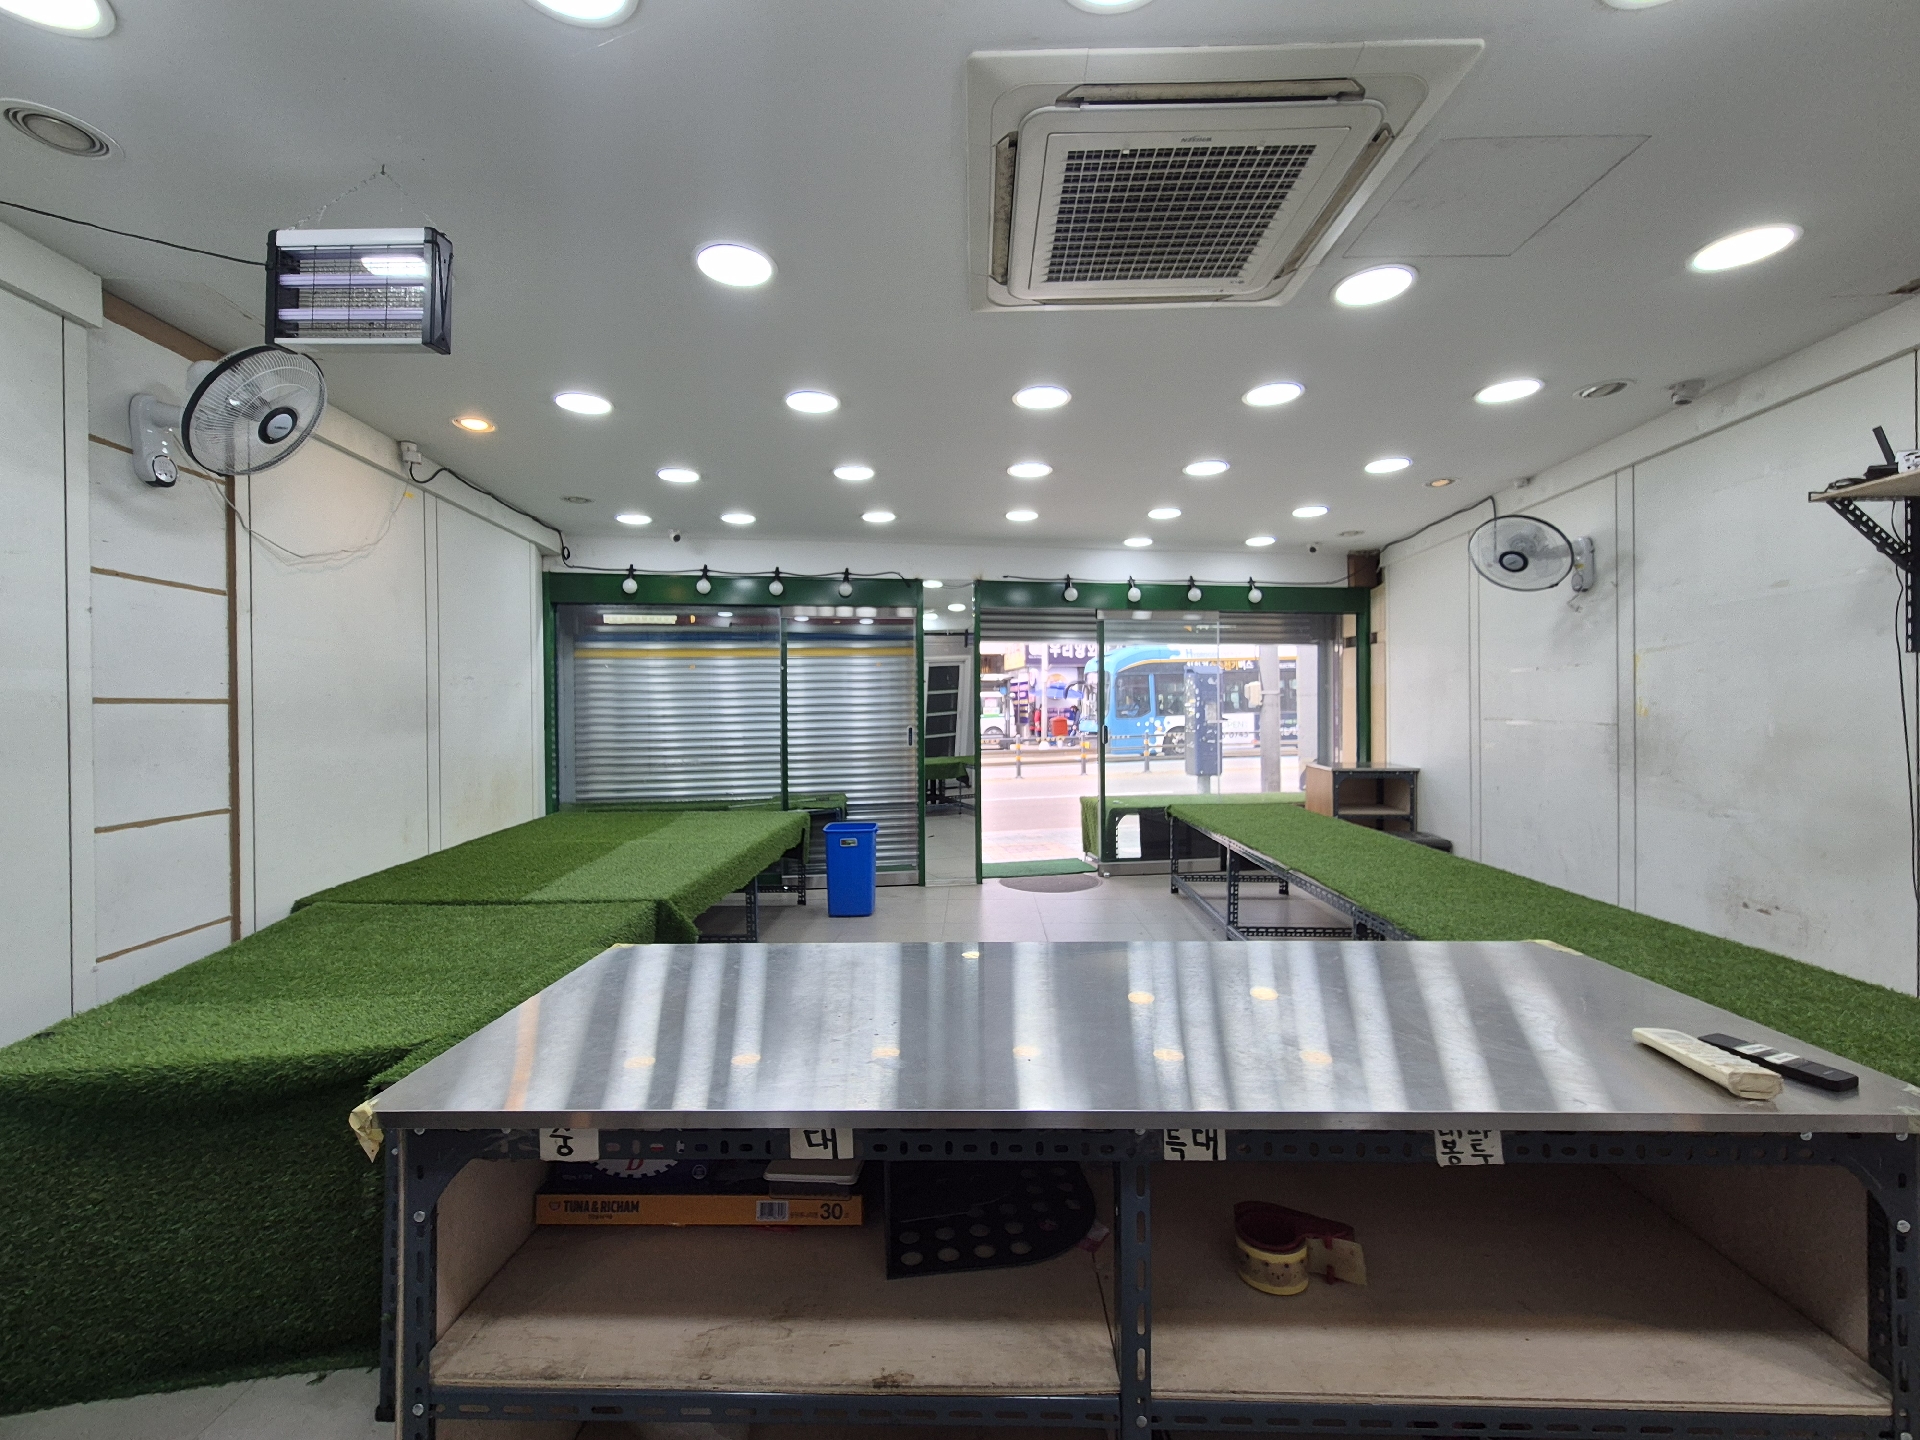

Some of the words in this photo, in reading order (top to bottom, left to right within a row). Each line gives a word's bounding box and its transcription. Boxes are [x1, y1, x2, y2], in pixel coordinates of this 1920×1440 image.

[802, 1128, 839, 1160] 대
[563, 1200, 590, 1213] TUNA
[600, 1200, 640, 1213] RICHAM
[820, 1203, 843, 1220] 30
